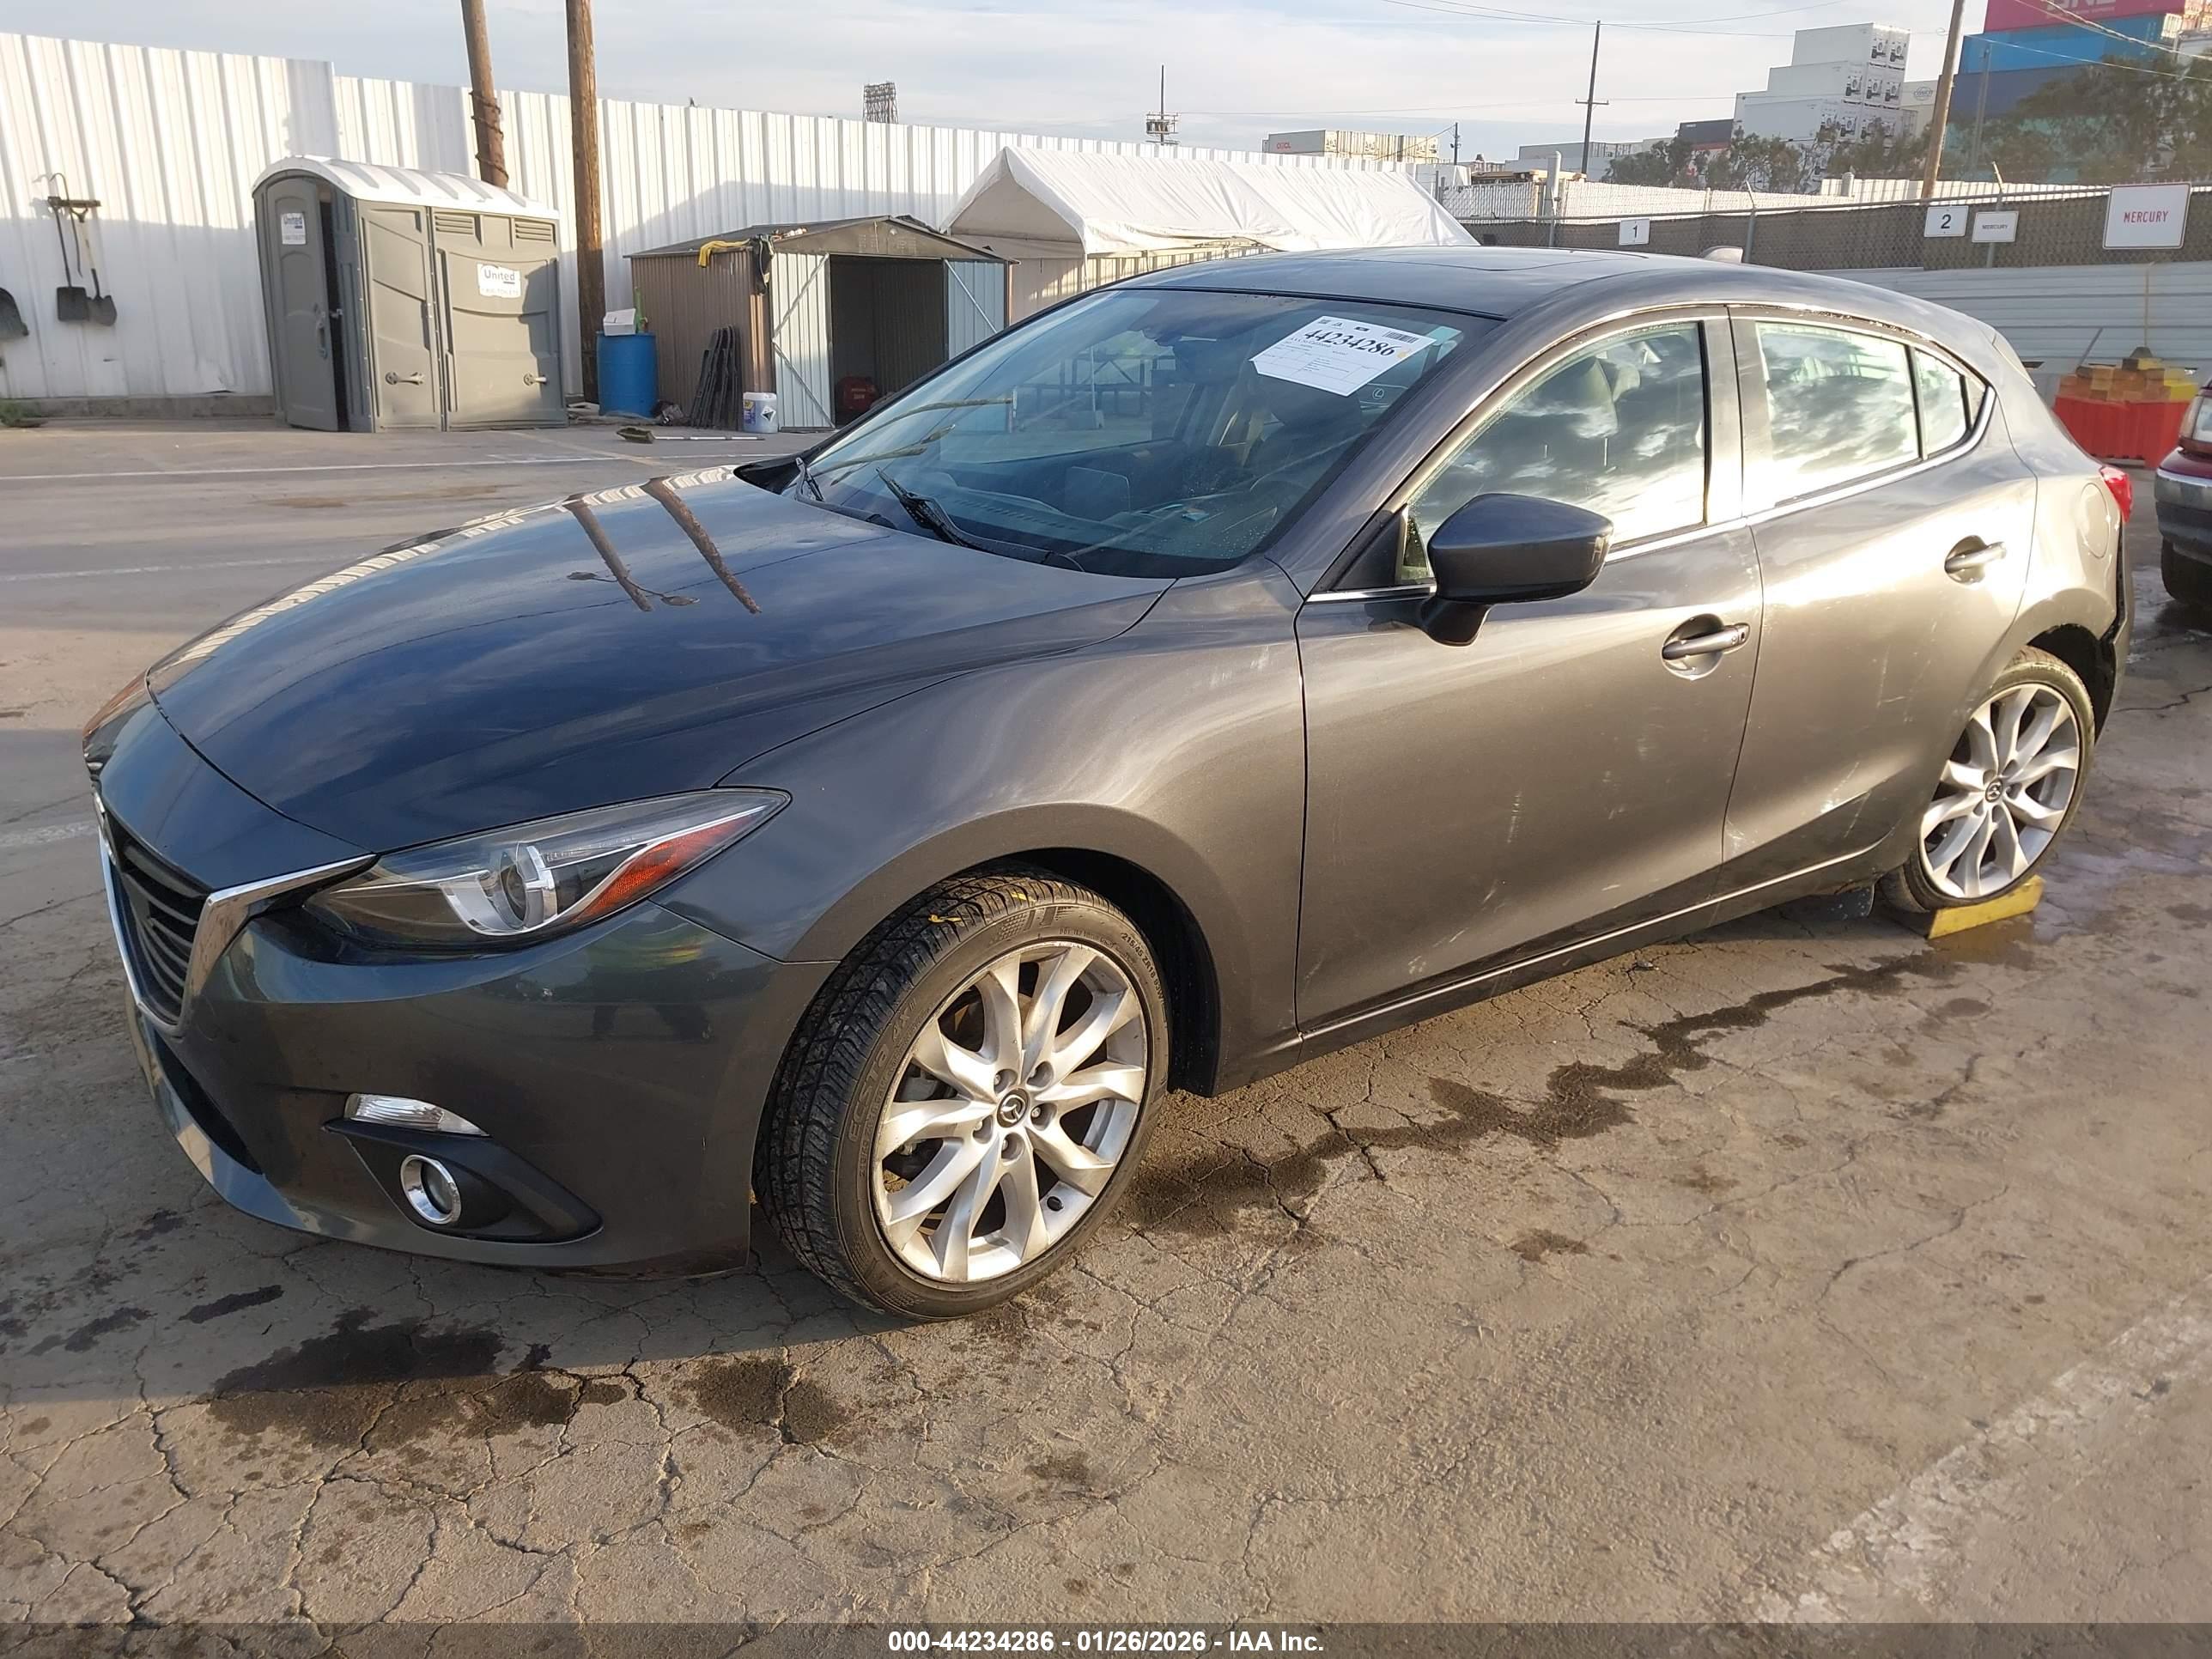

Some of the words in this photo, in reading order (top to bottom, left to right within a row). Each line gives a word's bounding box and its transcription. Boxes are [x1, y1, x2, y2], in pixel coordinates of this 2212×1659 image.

[1941, 214, 1952, 228] 2
[2124, 210, 2168, 223] MERCURY
[1632, 225, 1638, 238] 1
[483, 269, 515, 280] United
[1304, 329, 1401, 356] 44234286
